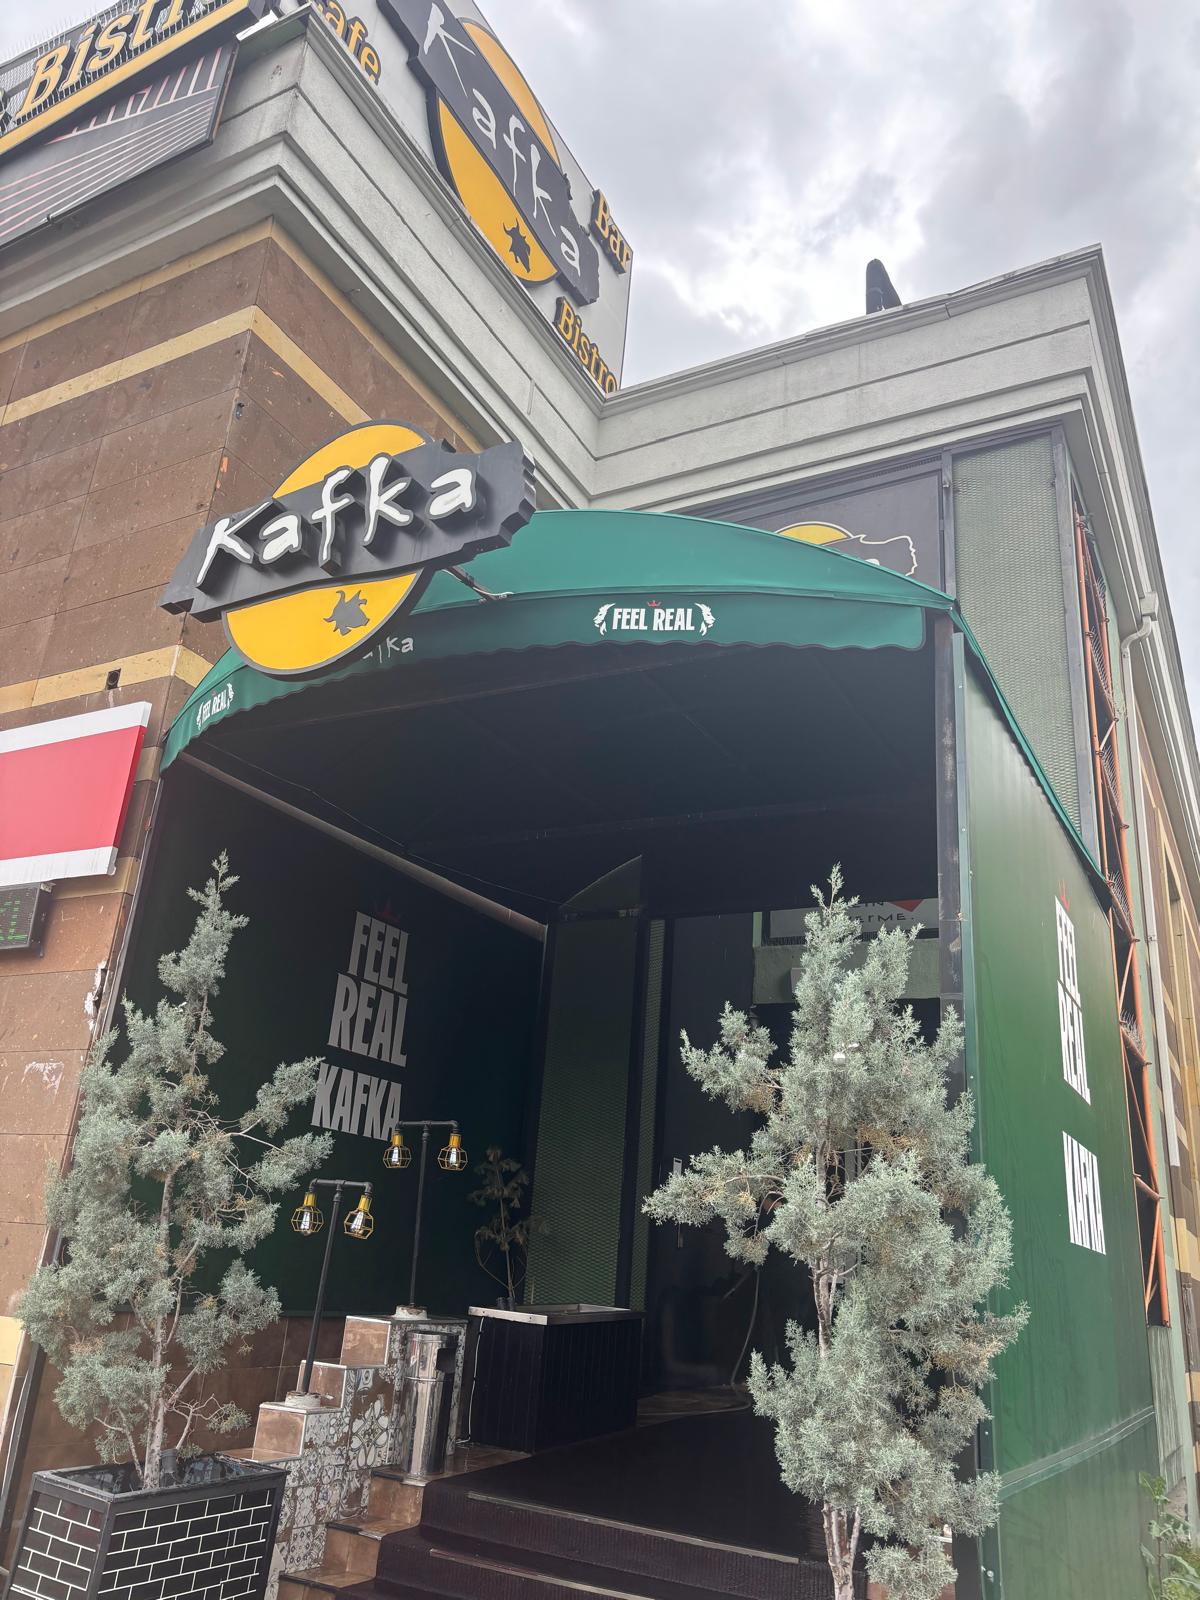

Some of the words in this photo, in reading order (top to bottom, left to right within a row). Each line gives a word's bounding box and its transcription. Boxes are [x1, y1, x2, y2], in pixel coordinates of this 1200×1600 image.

[317, 0, 379, 81] afe
[423, 2, 581, 277] Kafka
[595, 191, 630, 272] Bar
[558, 301, 618, 392] Bistro
[195, 453, 476, 586] Kafka
[611, 607, 648, 631] FEEL
[652, 607, 695, 631] REAL
[347, 910, 410, 996] FEEL
[326, 972, 408, 1068] REAL
[310, 1062, 402, 1143] KAFKA
